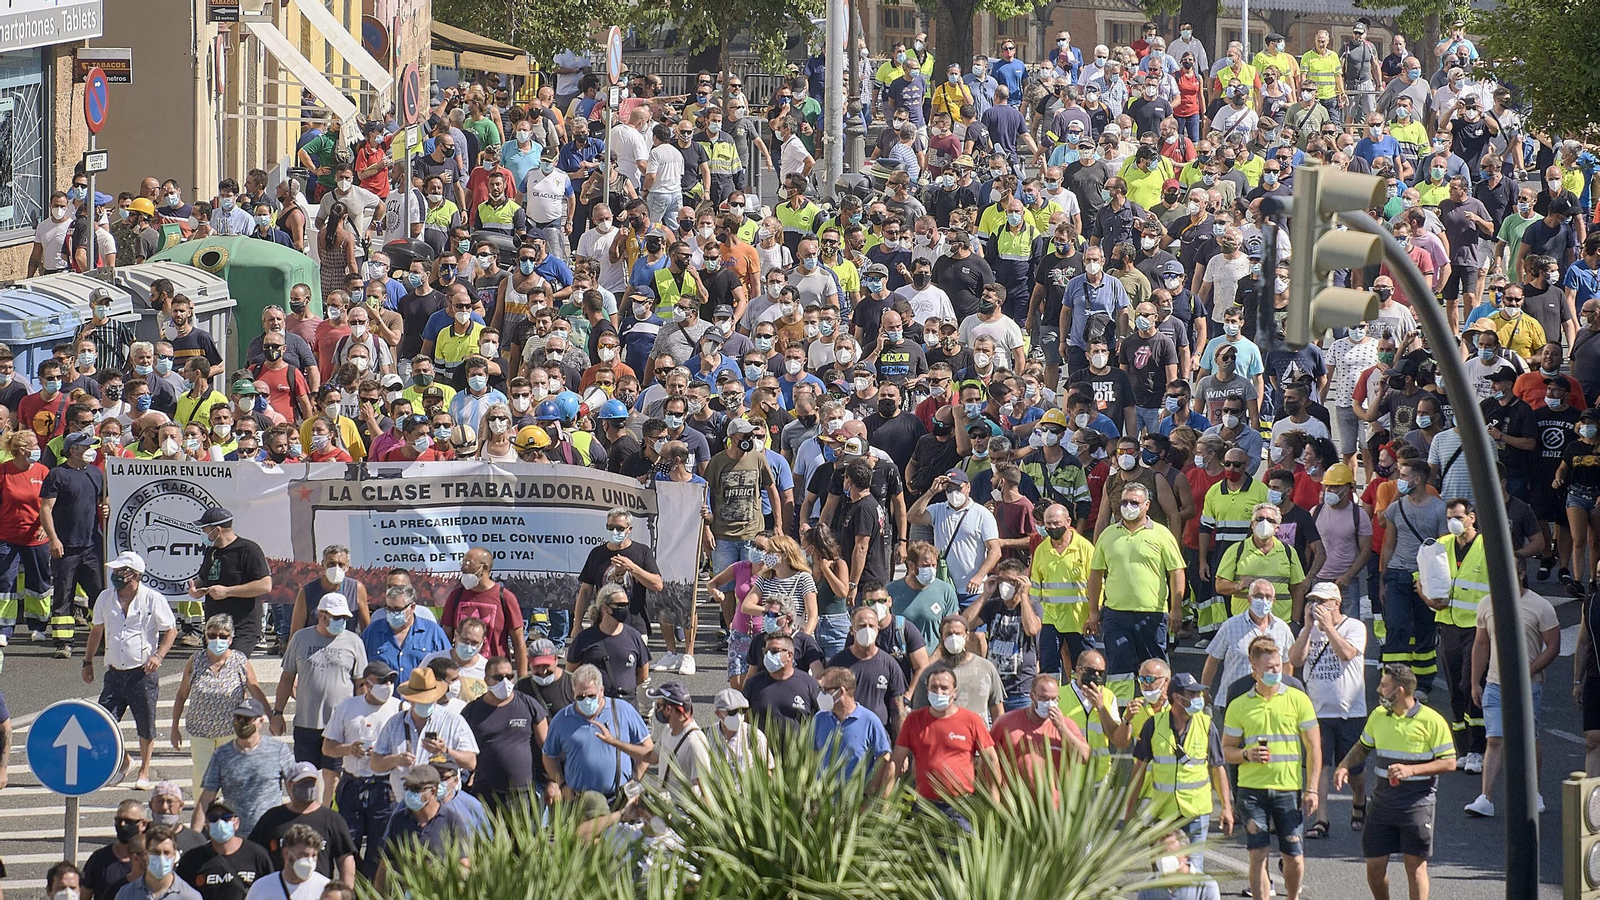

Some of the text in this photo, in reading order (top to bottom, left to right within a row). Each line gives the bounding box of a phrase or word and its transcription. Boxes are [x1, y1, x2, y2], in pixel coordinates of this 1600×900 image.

[61, 7, 97, 32] Tablets
[532, 191, 557, 199] GRACIAS
[886, 353, 896, 361] I'M
[882, 366, 908, 374] GENIUS
[1206, 387, 1243, 398] WINGS
[111, 464, 232, 478] LA AUXILIAR EN LUCHA
[135, 488, 152, 505] DE
[329, 482, 648, 510] LA CLASE TRABAJADORA UNIDA
[165, 517, 180, 526] METAL
[380, 520, 397, 529] LA
[400, 516, 488, 528] PRECARIEDAD
[491, 516, 526, 526] MATA
[382, 533, 478, 546] CUMPLIMIENTO
[481, 533, 506, 543] DEL
[509, 535, 574, 544] CONVENIO
[578, 536, 606, 545] 100%
[384, 553, 425, 563] CARGA
[429, 553, 446, 562] DE
[449, 551, 506, 563] TRJO
[510, 551, 534, 560] ¡YA!
